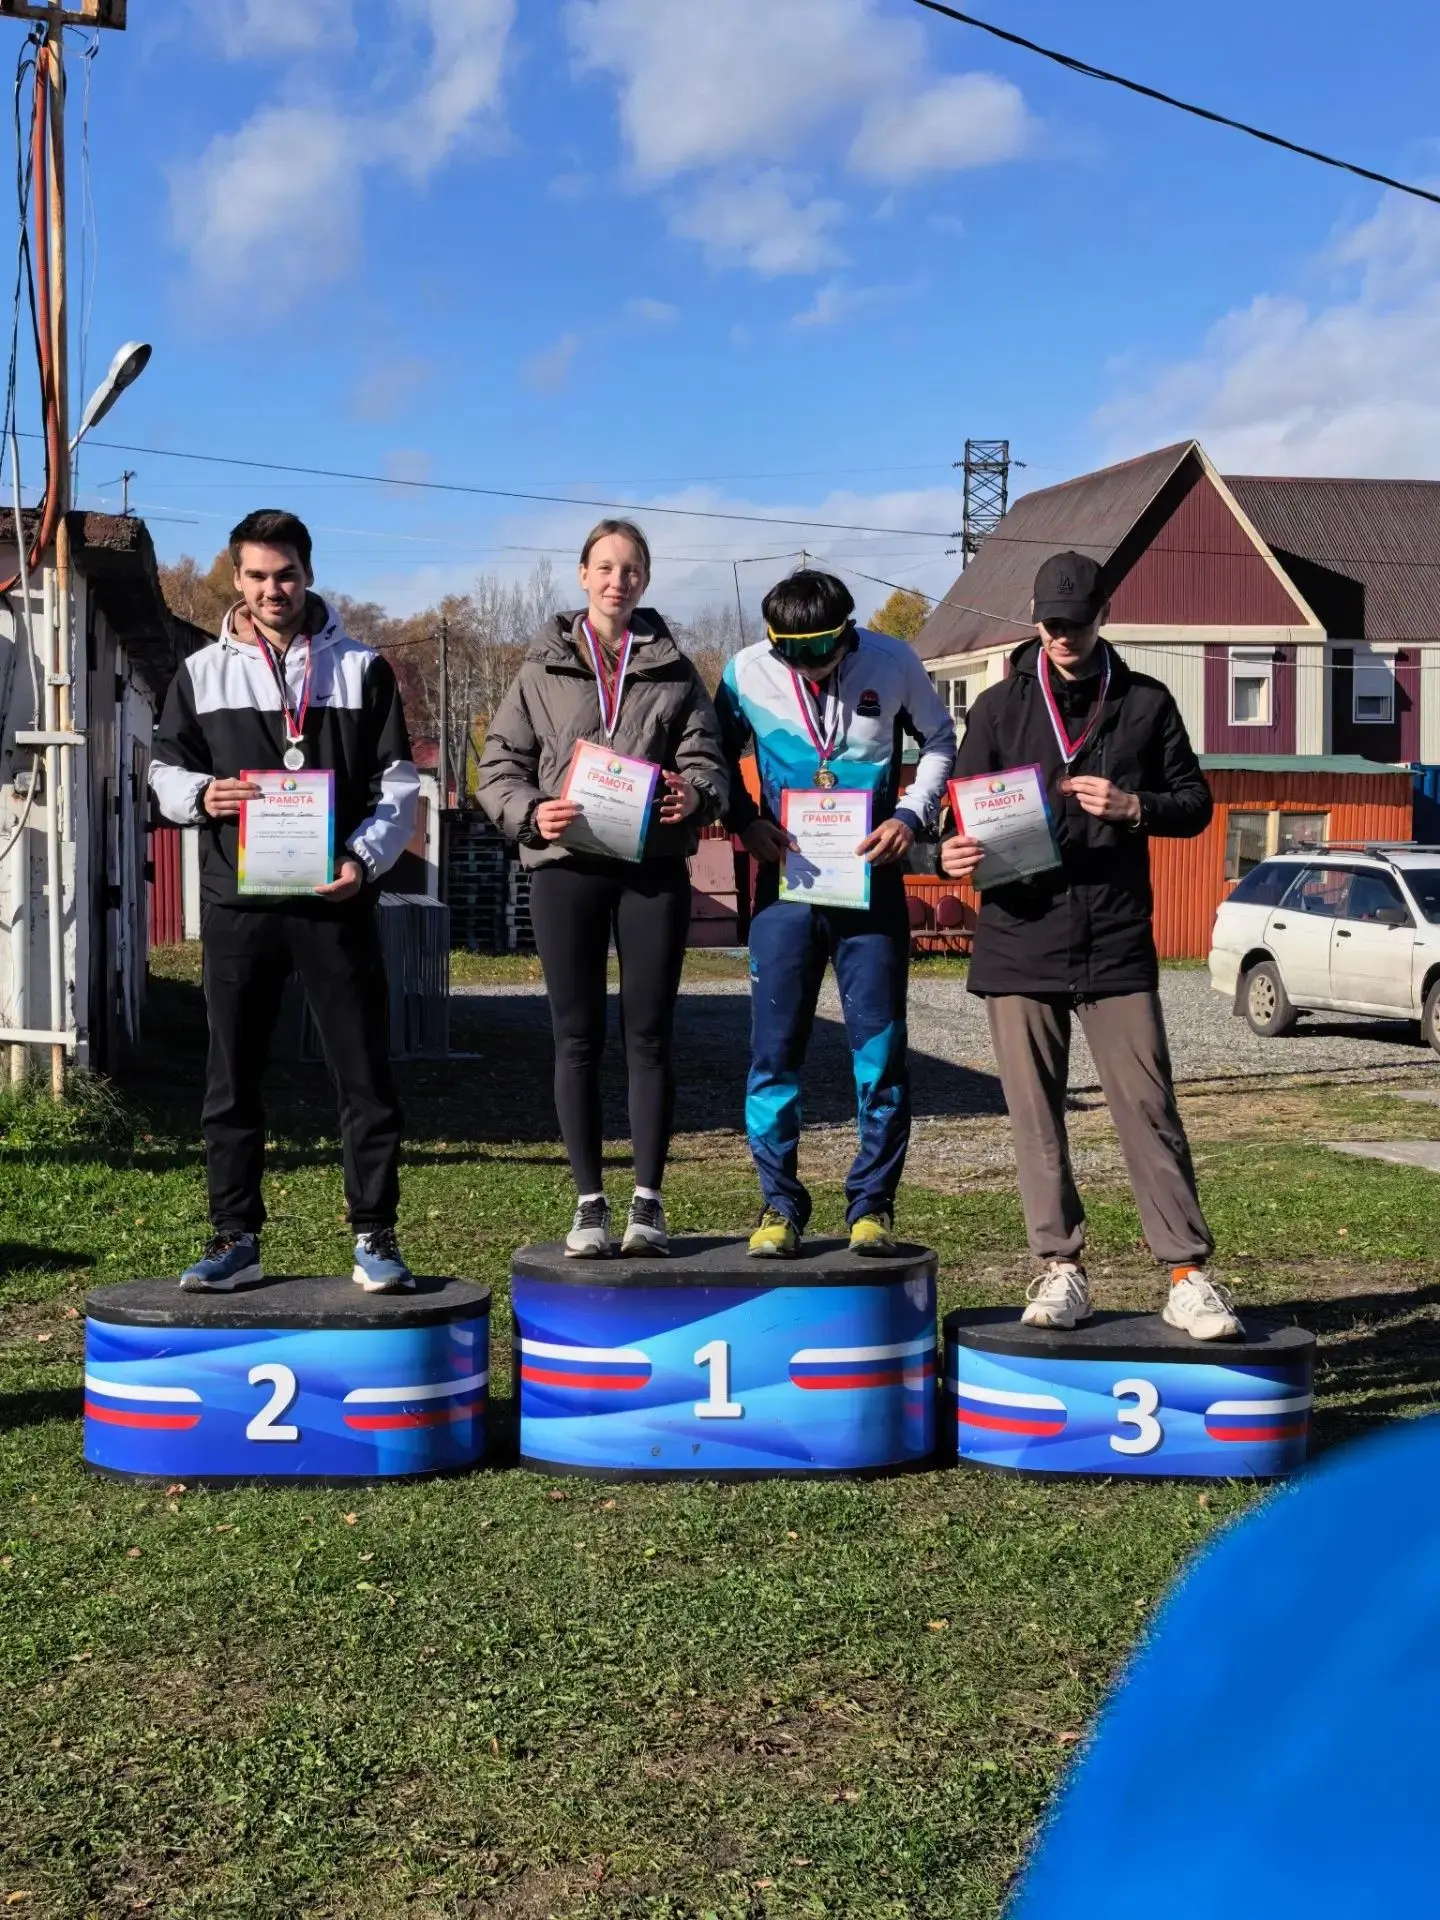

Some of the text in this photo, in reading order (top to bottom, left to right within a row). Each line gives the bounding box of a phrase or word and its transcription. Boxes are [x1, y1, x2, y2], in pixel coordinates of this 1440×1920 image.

[587, 771, 633, 793] ГРАМОТА
[263, 795, 314, 804] ГРАМОТА
[974, 793, 1026, 811] ГРАМОТА
[802, 814, 851, 823] ГРАМОТА
[693, 1340, 743, 1419] 1
[246, 1363, 298, 1440] 2
[1110, 1379, 1162, 1455] 3
